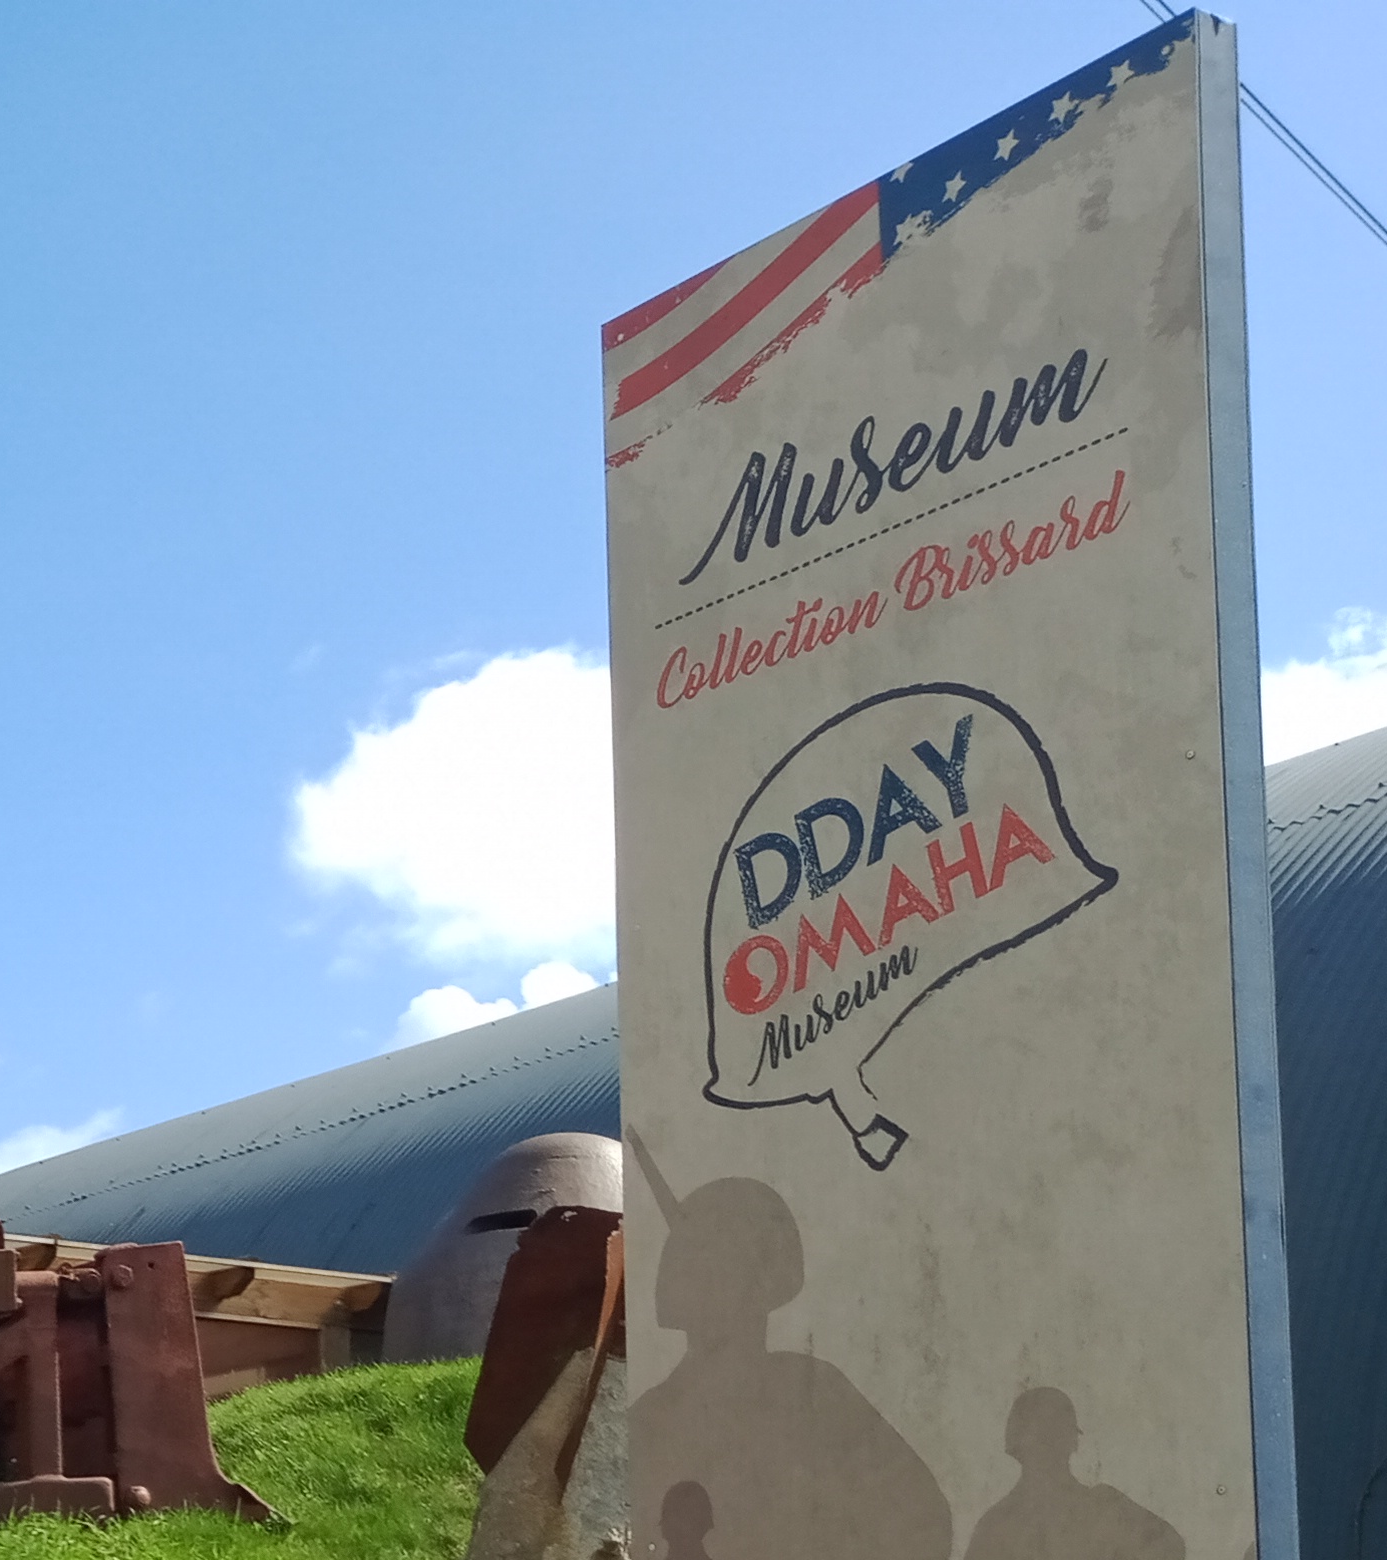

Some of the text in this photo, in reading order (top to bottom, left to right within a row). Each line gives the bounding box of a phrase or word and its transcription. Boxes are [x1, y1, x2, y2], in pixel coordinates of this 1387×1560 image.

[679, 348, 1108, 585] Museum
[655, 469, 1130, 709] Collection Brissard
[723, 804, 1055, 1015] OMAHA
[734, 713, 974, 930] DDAY
[748, 946, 918, 1087] Museum
